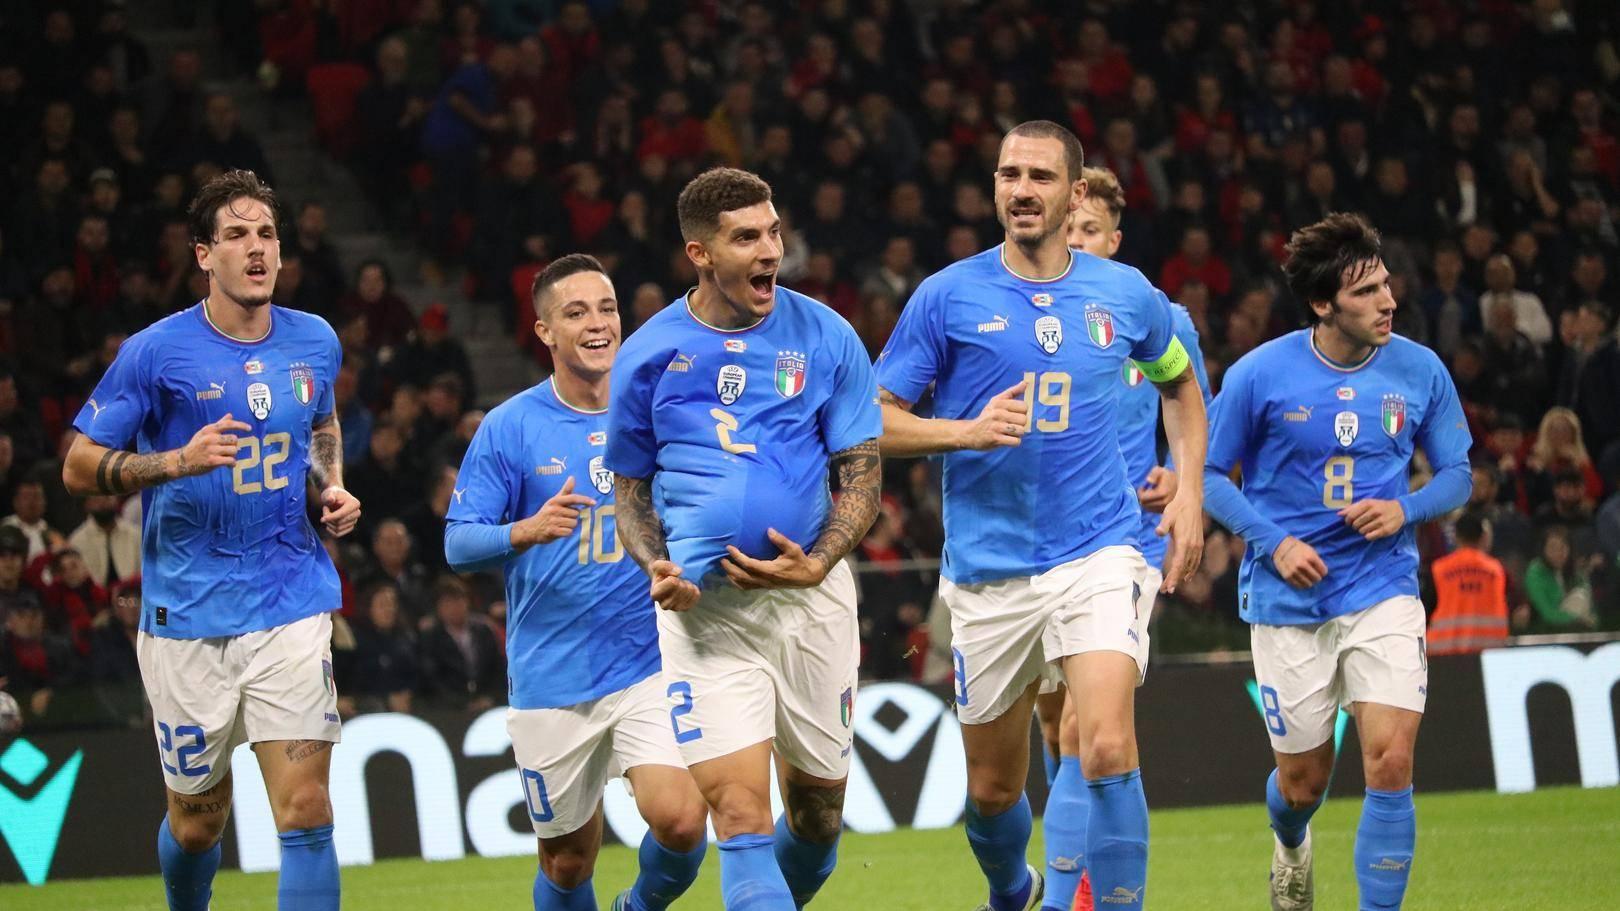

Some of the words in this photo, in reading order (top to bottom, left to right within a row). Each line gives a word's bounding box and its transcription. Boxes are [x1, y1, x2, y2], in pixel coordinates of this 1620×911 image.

[977, 322, 1005, 333] PUMA
[667, 361, 688, 372] UMA
[778, 360, 804, 369] ITALIA
[1153, 348, 1183, 376] RESPECT
[196, 389, 221, 401] PUMA
[1023, 371, 1073, 433] 19
[1283, 412, 1307, 422] PUMA
[709, 407, 757, 454] 2
[232, 431, 291, 495] 22
[536, 464, 562, 476] PUMA
[1322, 455, 1354, 510] 8
[577, 504, 624, 565] 10
[666, 680, 704, 744] 2
[1260, 684, 1288, 737] 8
[157, 719, 212, 777] 22
